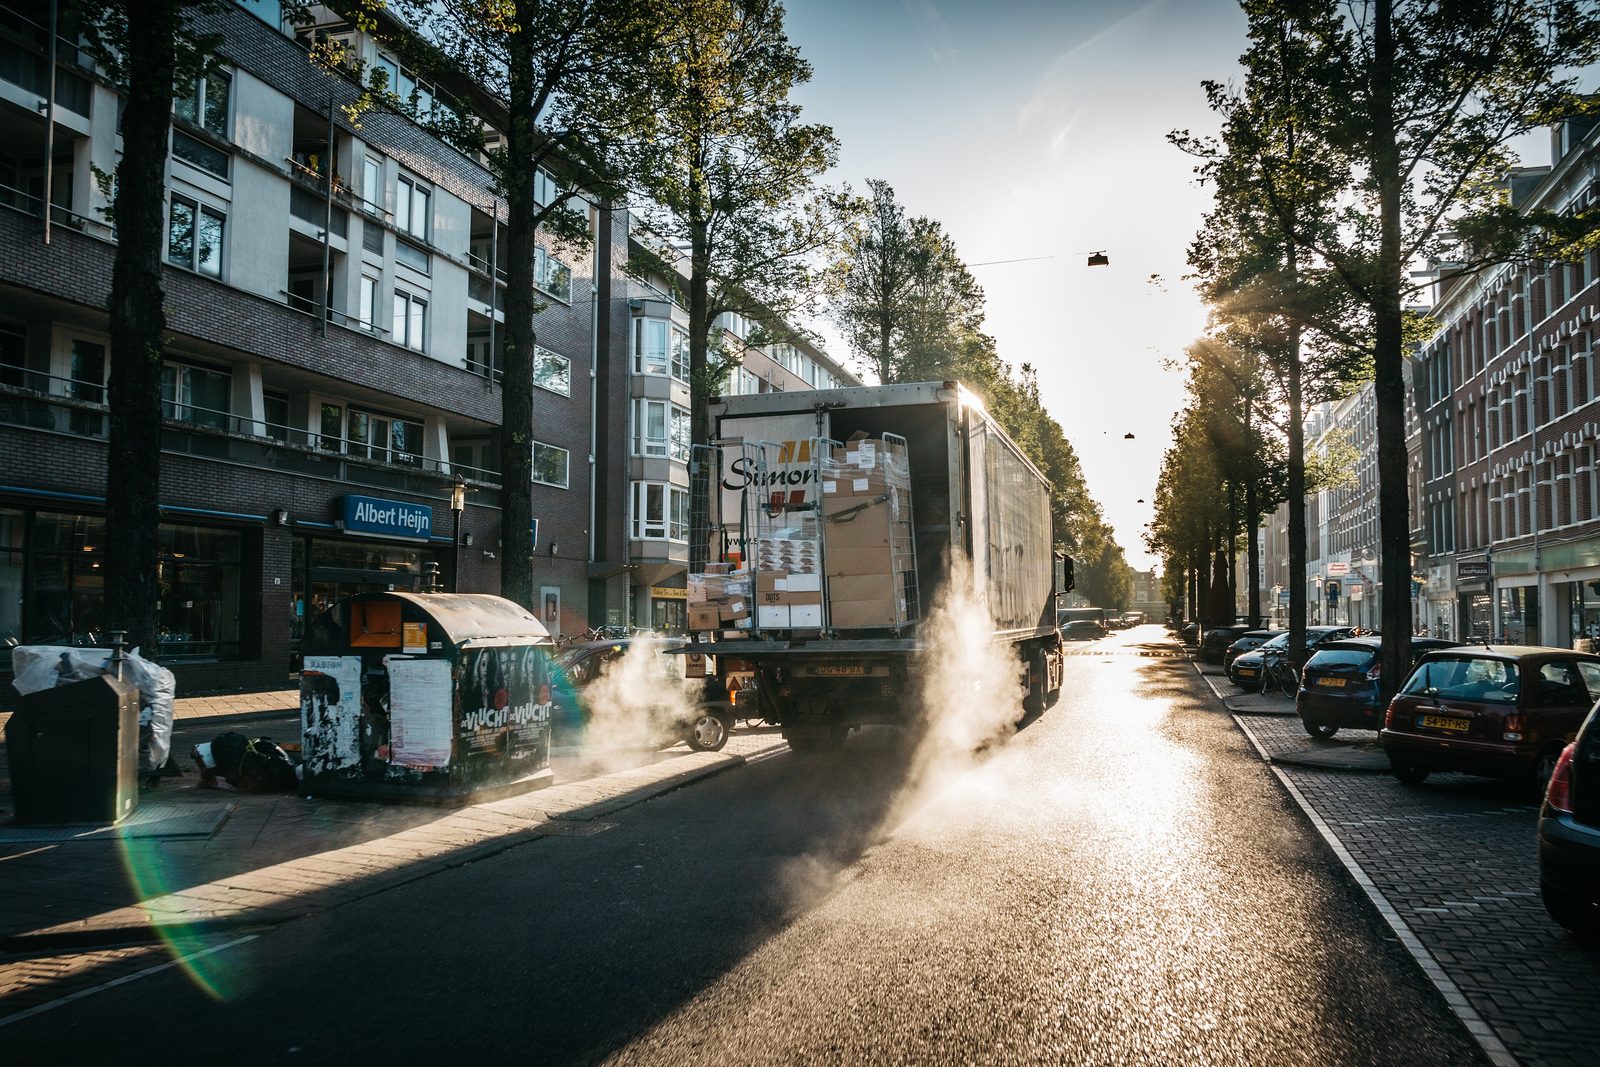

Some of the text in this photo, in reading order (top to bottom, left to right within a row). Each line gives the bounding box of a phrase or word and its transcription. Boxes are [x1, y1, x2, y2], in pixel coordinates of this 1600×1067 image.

[722, 457, 819, 490] Simon
[354, 502, 429, 533] Albert Heijn
[465, 706, 509, 732] VLUCHT
[514, 701, 552, 725] VLUCHT
